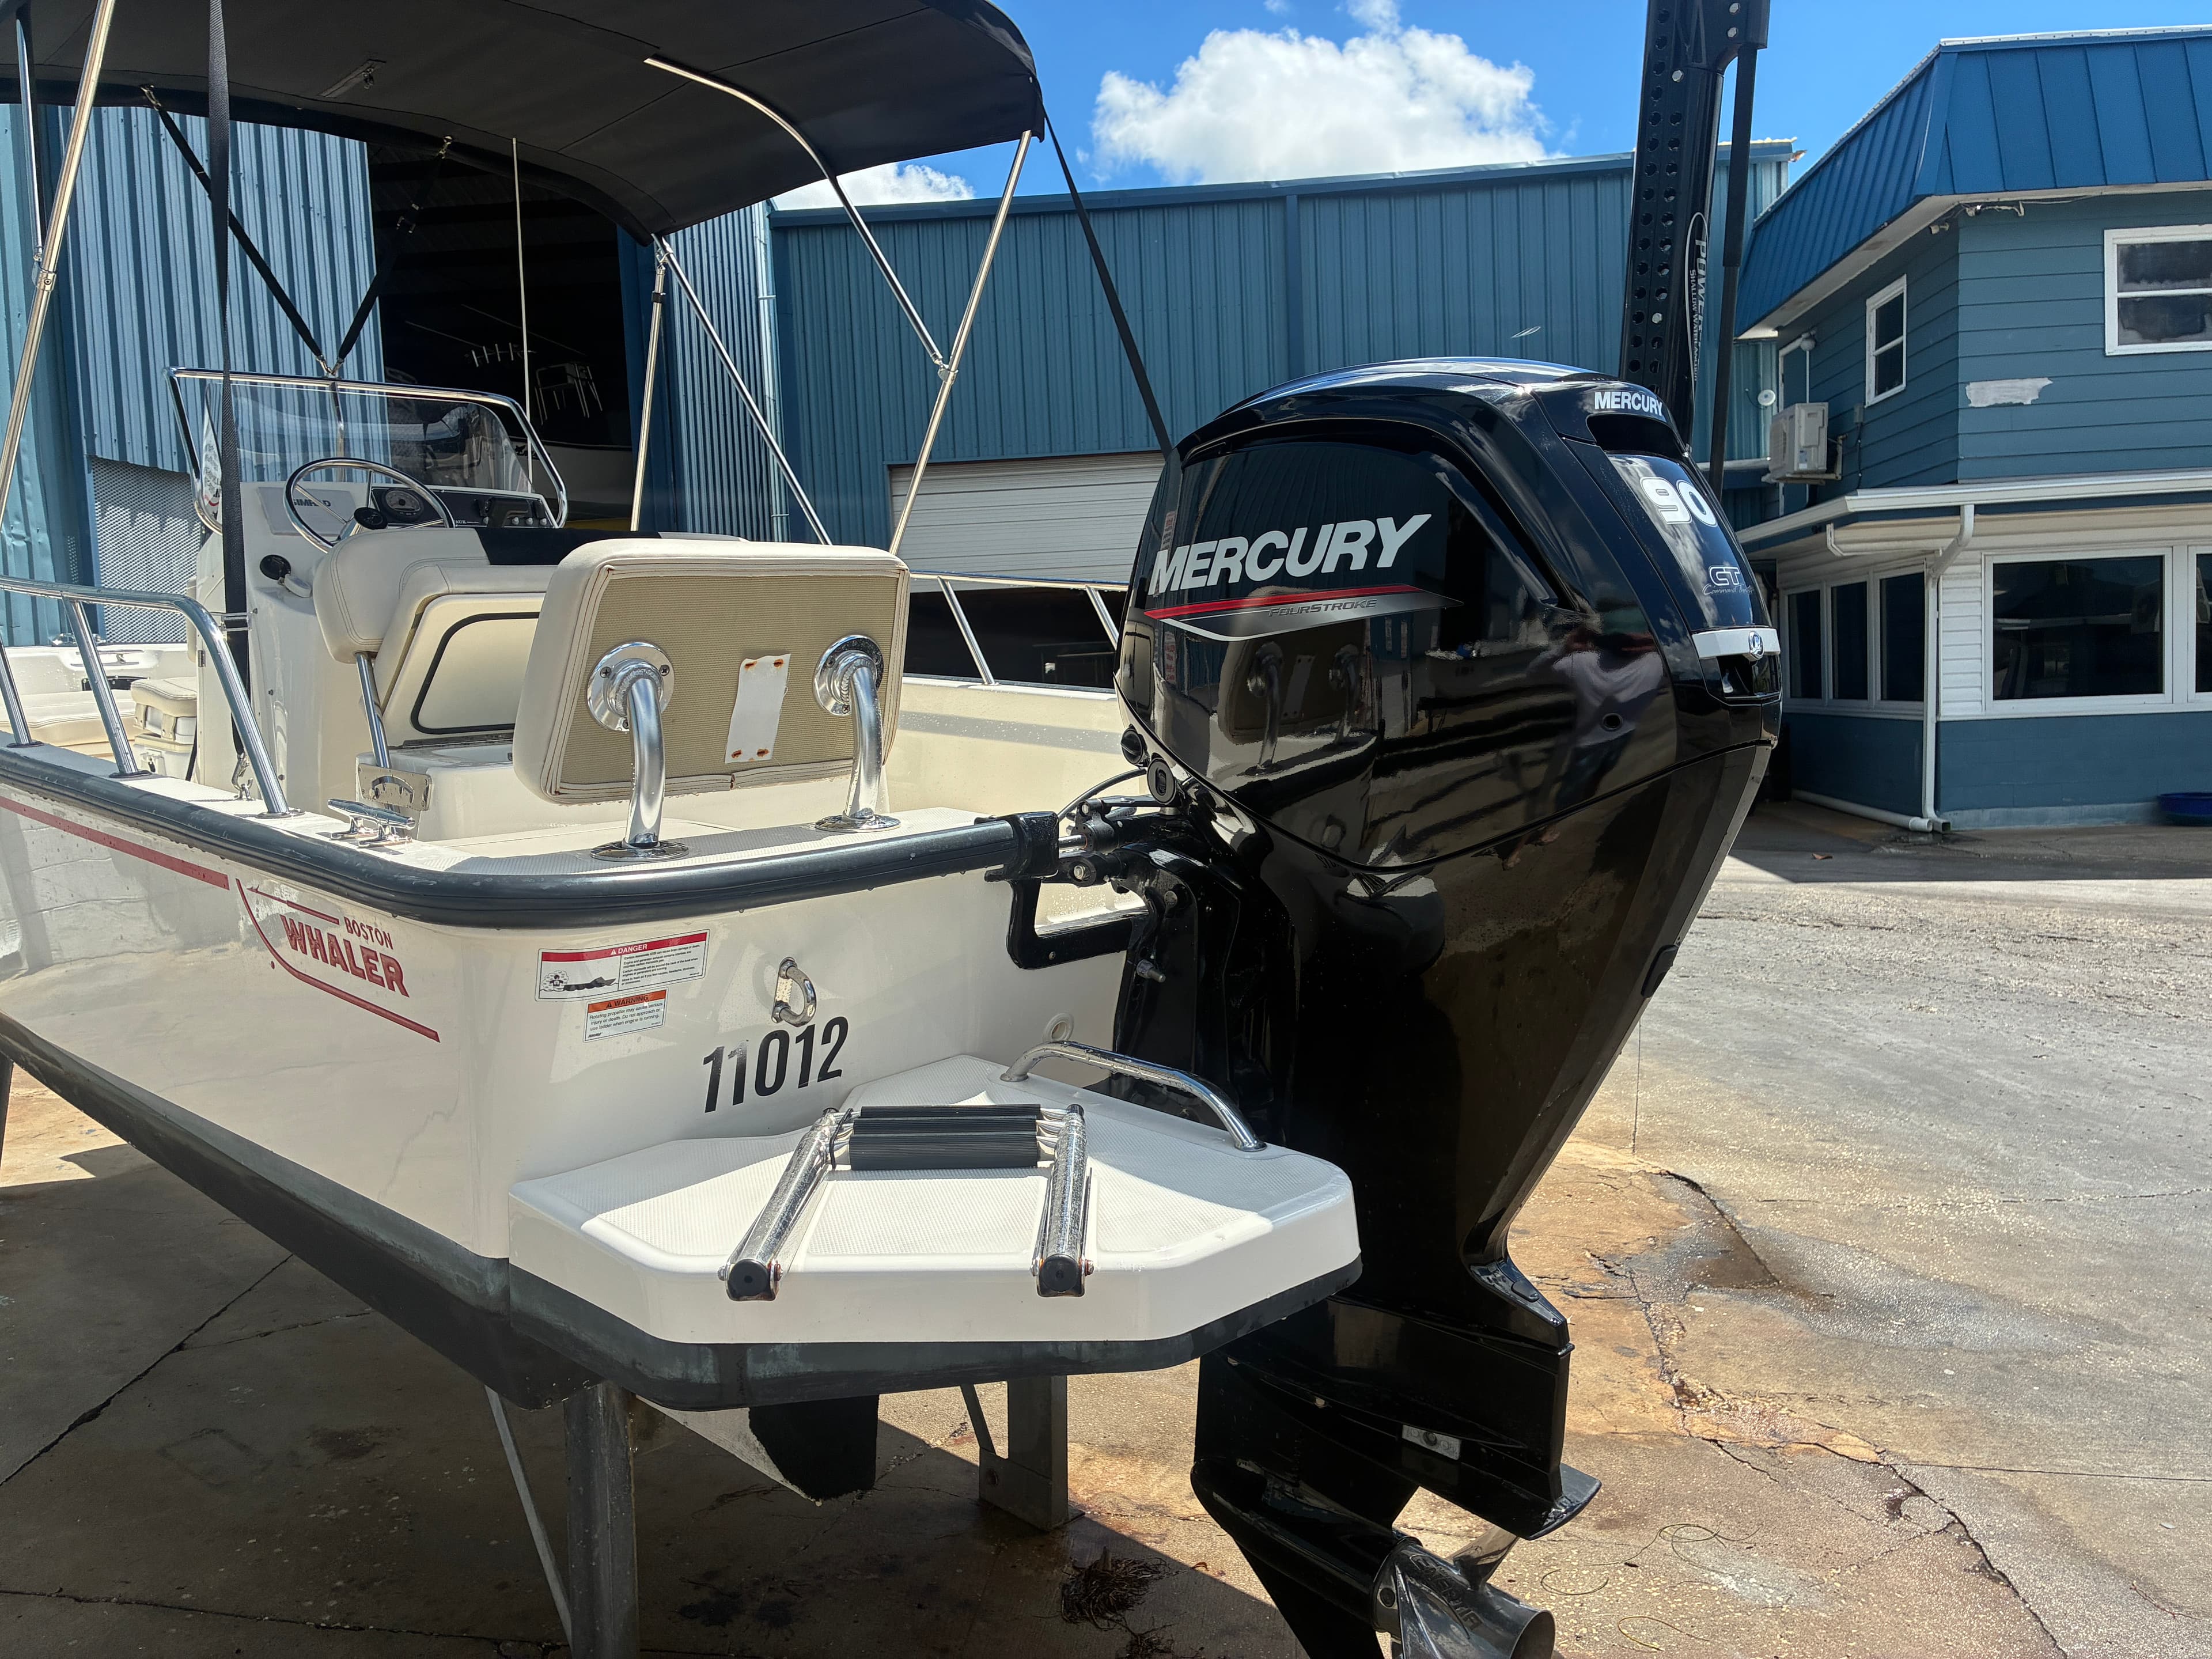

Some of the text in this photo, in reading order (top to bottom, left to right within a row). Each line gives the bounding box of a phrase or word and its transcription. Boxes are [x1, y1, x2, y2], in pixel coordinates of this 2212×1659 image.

[1594, 391, 1663, 416] MERCURY
[1640, 476, 1718, 528] 90
[1148, 513, 1432, 596] MERCURY
[1268, 599, 1378, 616] FOURSTROKE
[344, 916, 393, 950] BOSTON
[618, 944, 647, 954] DANGER
[279, 914, 410, 998] WHALER
[614, 995, 649, 1006] WARNING
[703, 1016, 849, 1113] 11012
